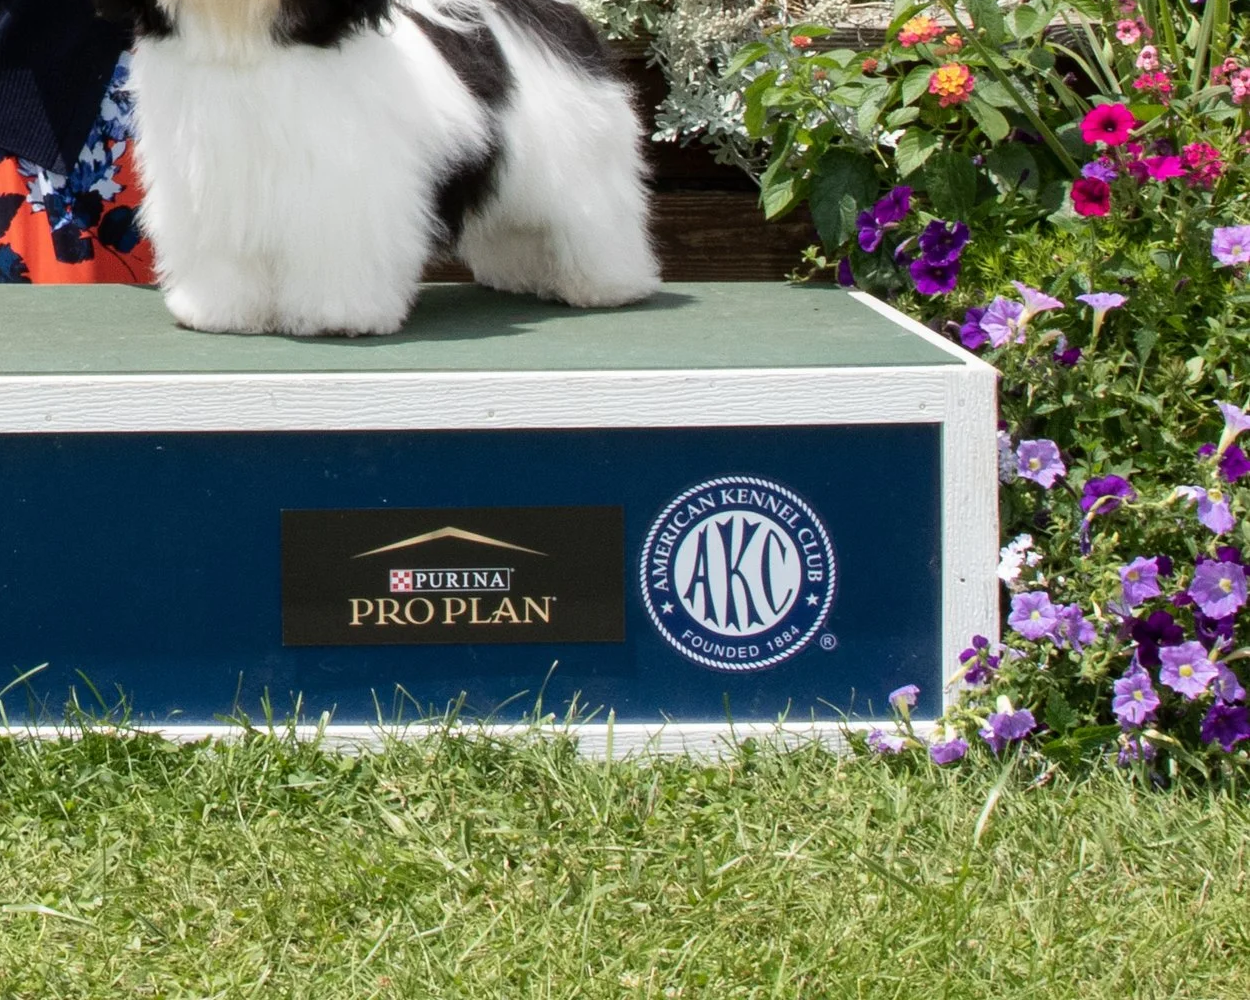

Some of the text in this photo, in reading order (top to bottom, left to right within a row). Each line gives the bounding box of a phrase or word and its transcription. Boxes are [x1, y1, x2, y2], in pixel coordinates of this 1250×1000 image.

[652, 487, 824, 592] AMERICAN KENNEL CLUB
[415, 571, 506, 589] PURINA
[682, 514, 794, 633] AKC
[348, 595, 552, 626] PRO PLAN
[681, 624, 800, 659] FOUNDED 1884
